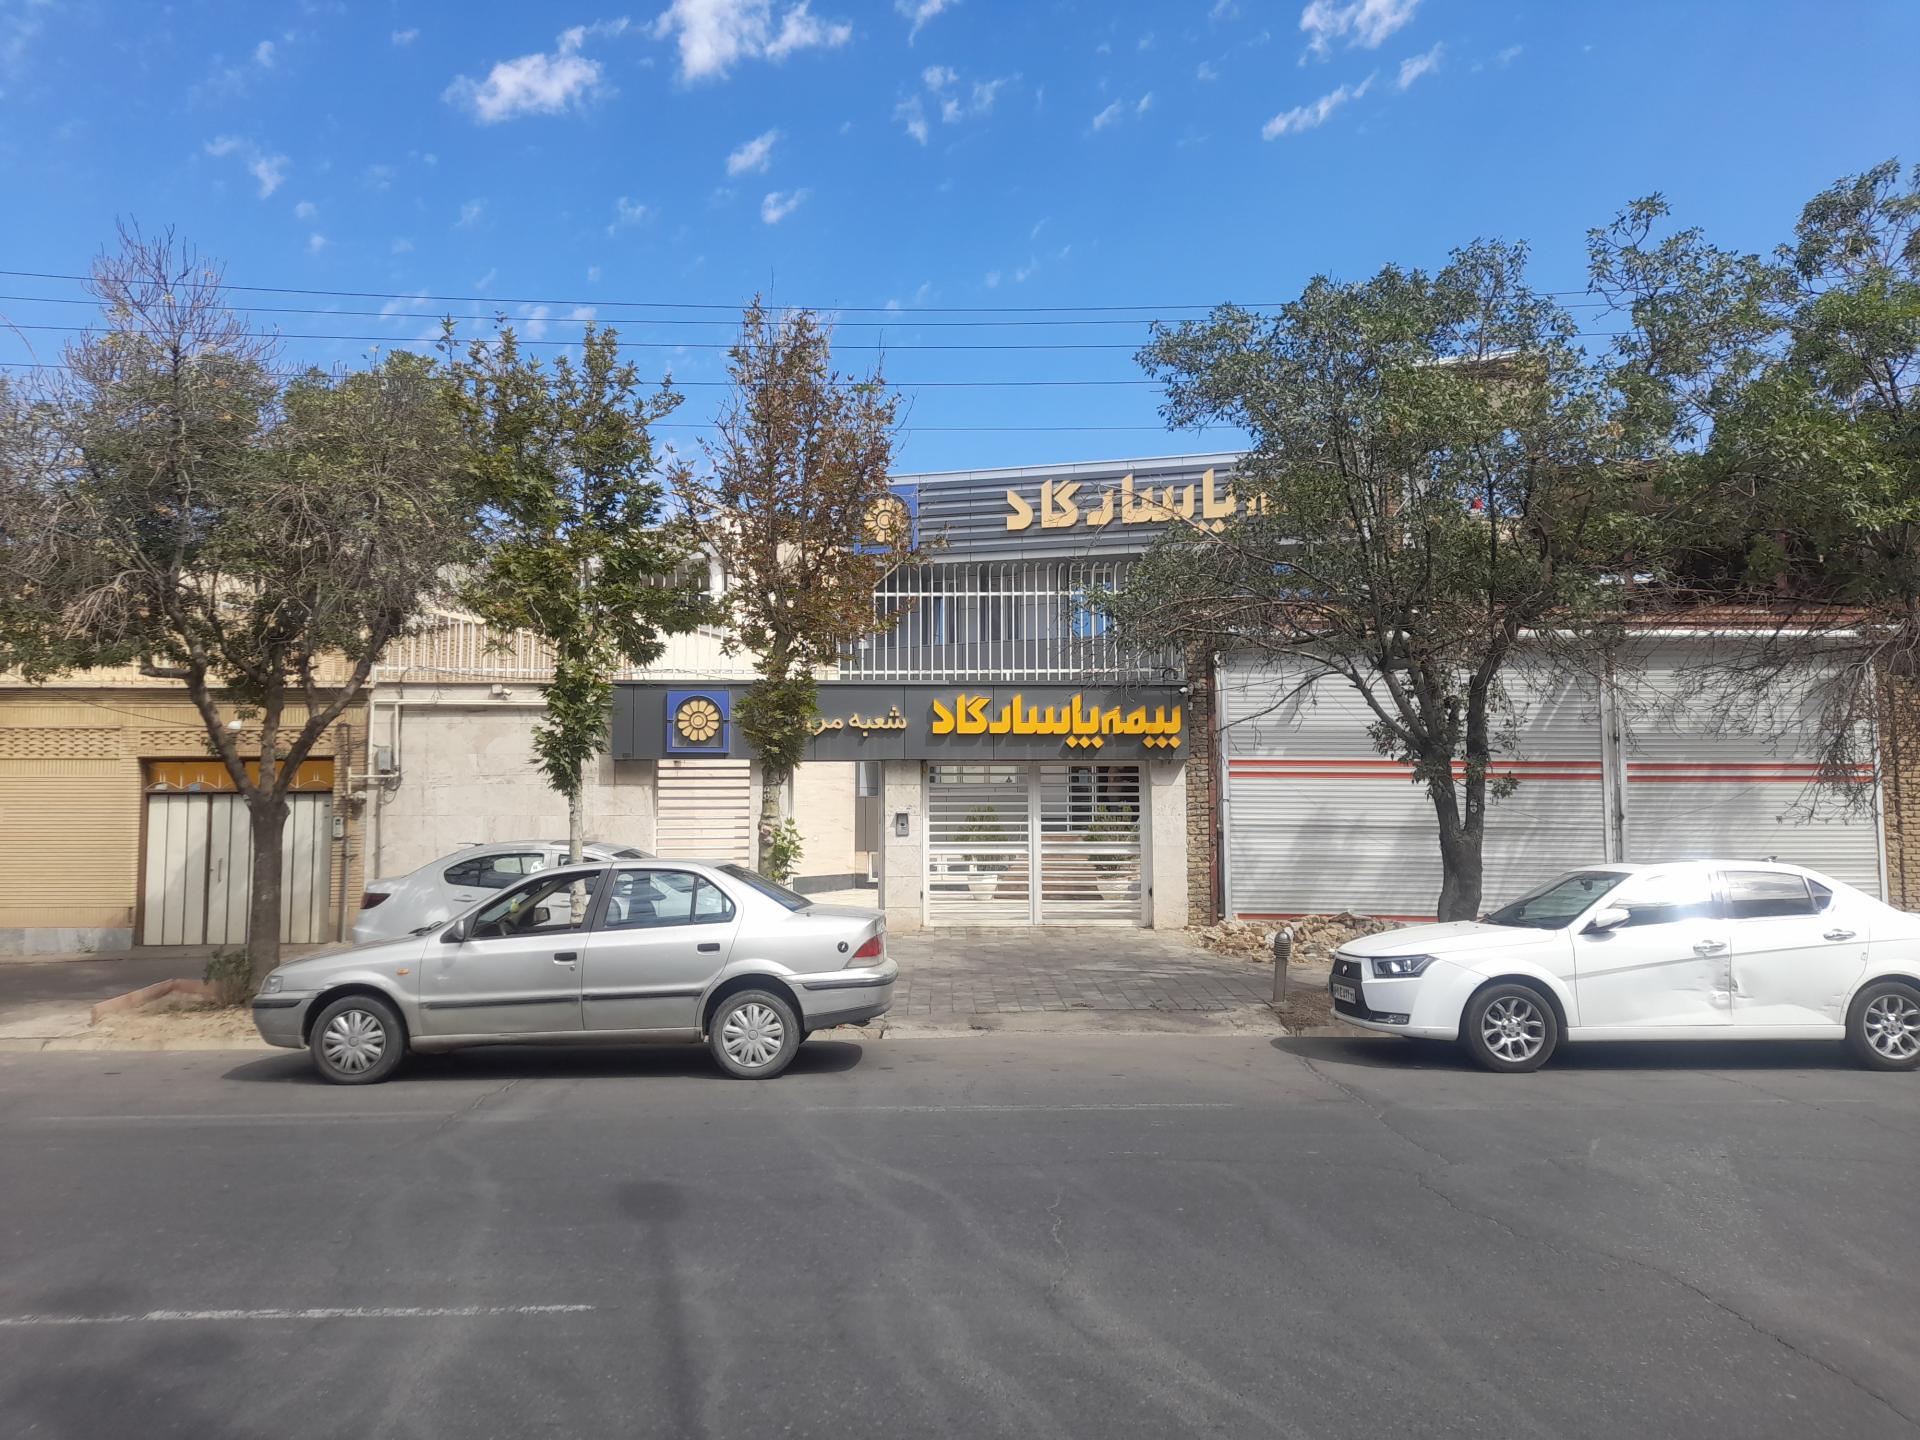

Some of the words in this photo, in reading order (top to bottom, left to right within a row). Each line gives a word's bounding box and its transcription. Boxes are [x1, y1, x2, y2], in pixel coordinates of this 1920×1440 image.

[848, 704, 908, 737] شعبه
[932, 693, 1104, 749] پاسارگاد
[1101, 704, 1182, 749] بیمه
